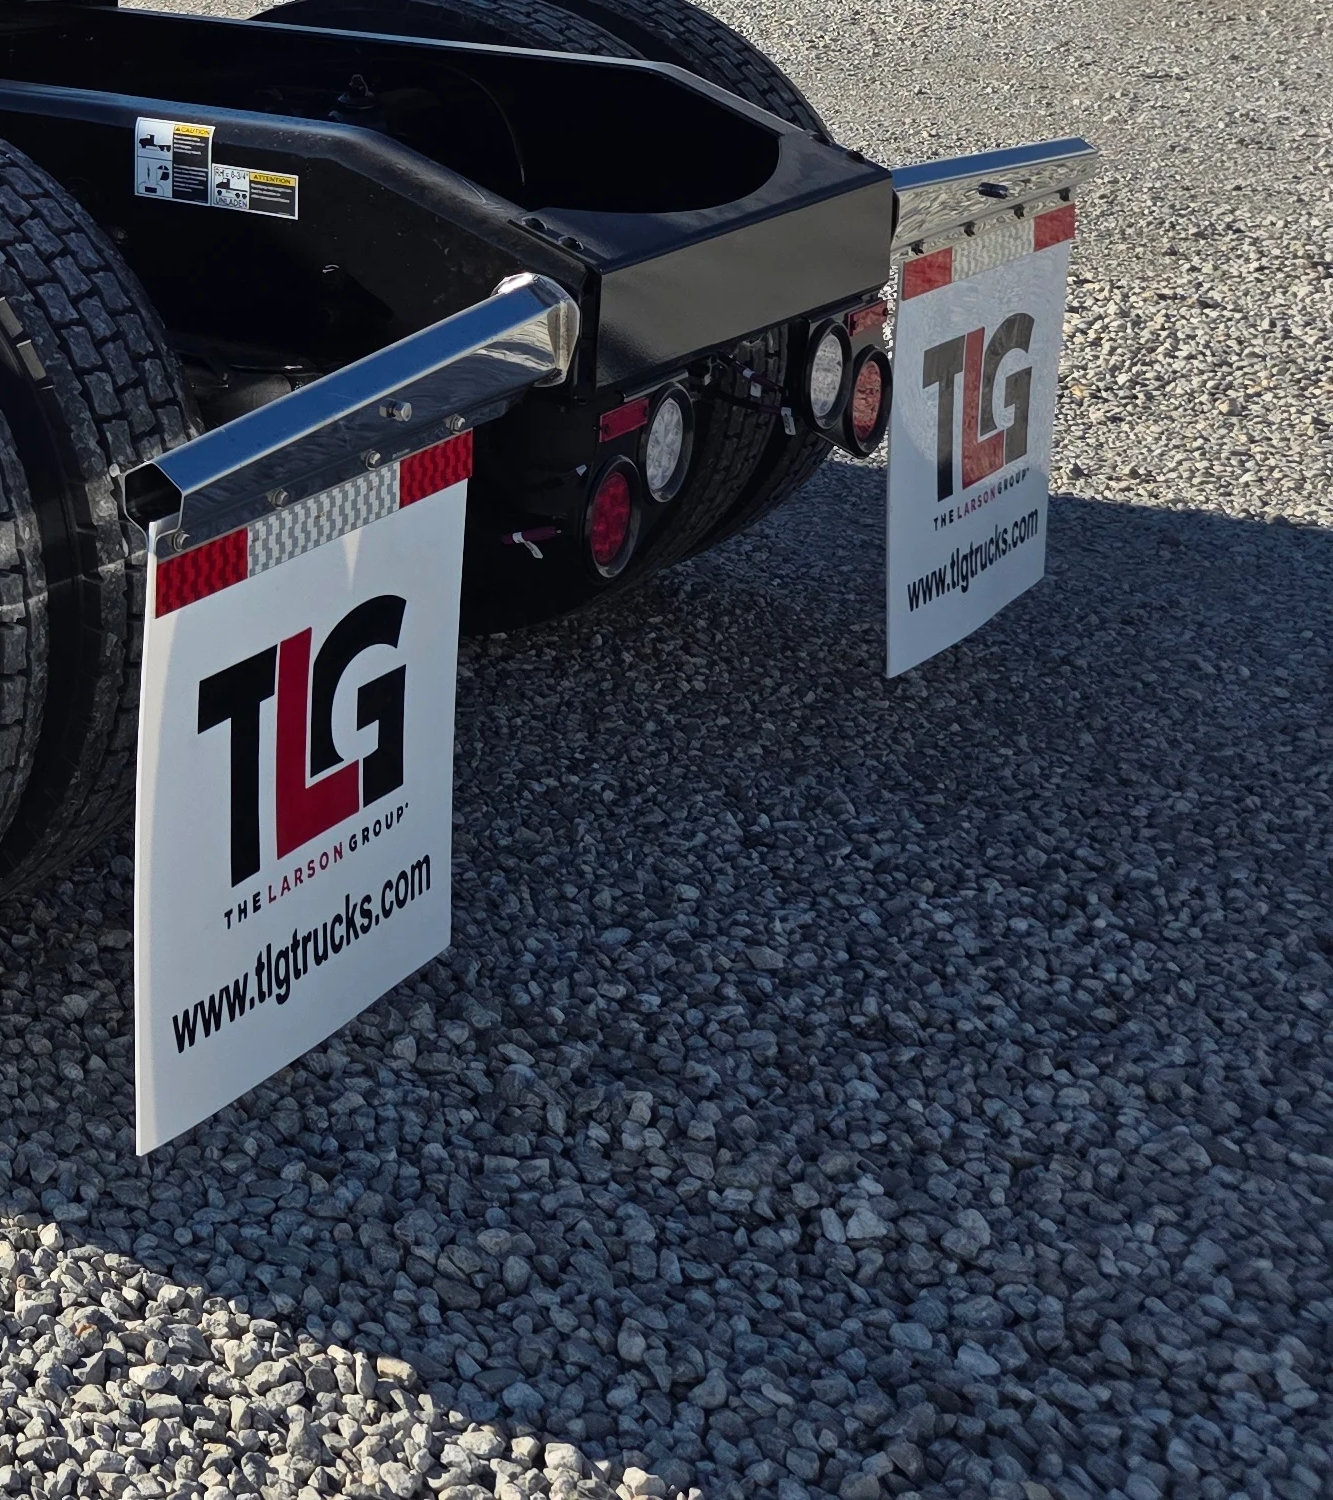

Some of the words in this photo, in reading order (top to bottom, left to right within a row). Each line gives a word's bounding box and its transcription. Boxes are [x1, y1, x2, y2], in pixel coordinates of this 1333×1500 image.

[180, 127, 211, 136] CAUTION
[215, 196, 248, 208] UNLADEN
[252, 175, 292, 185] ATTENTION
[923, 312, 1035, 502] TLG
[933, 509, 955, 531] THE
[957, 485, 996, 520] LARSON
[907, 508, 1038, 612] www.tlgtrucks.com
[197, 594, 407, 888] TLG
[223, 891, 262, 930] THE
[268, 841, 343, 904] LARSON
[171, 854, 432, 1053] www.tlgtrucks.com
